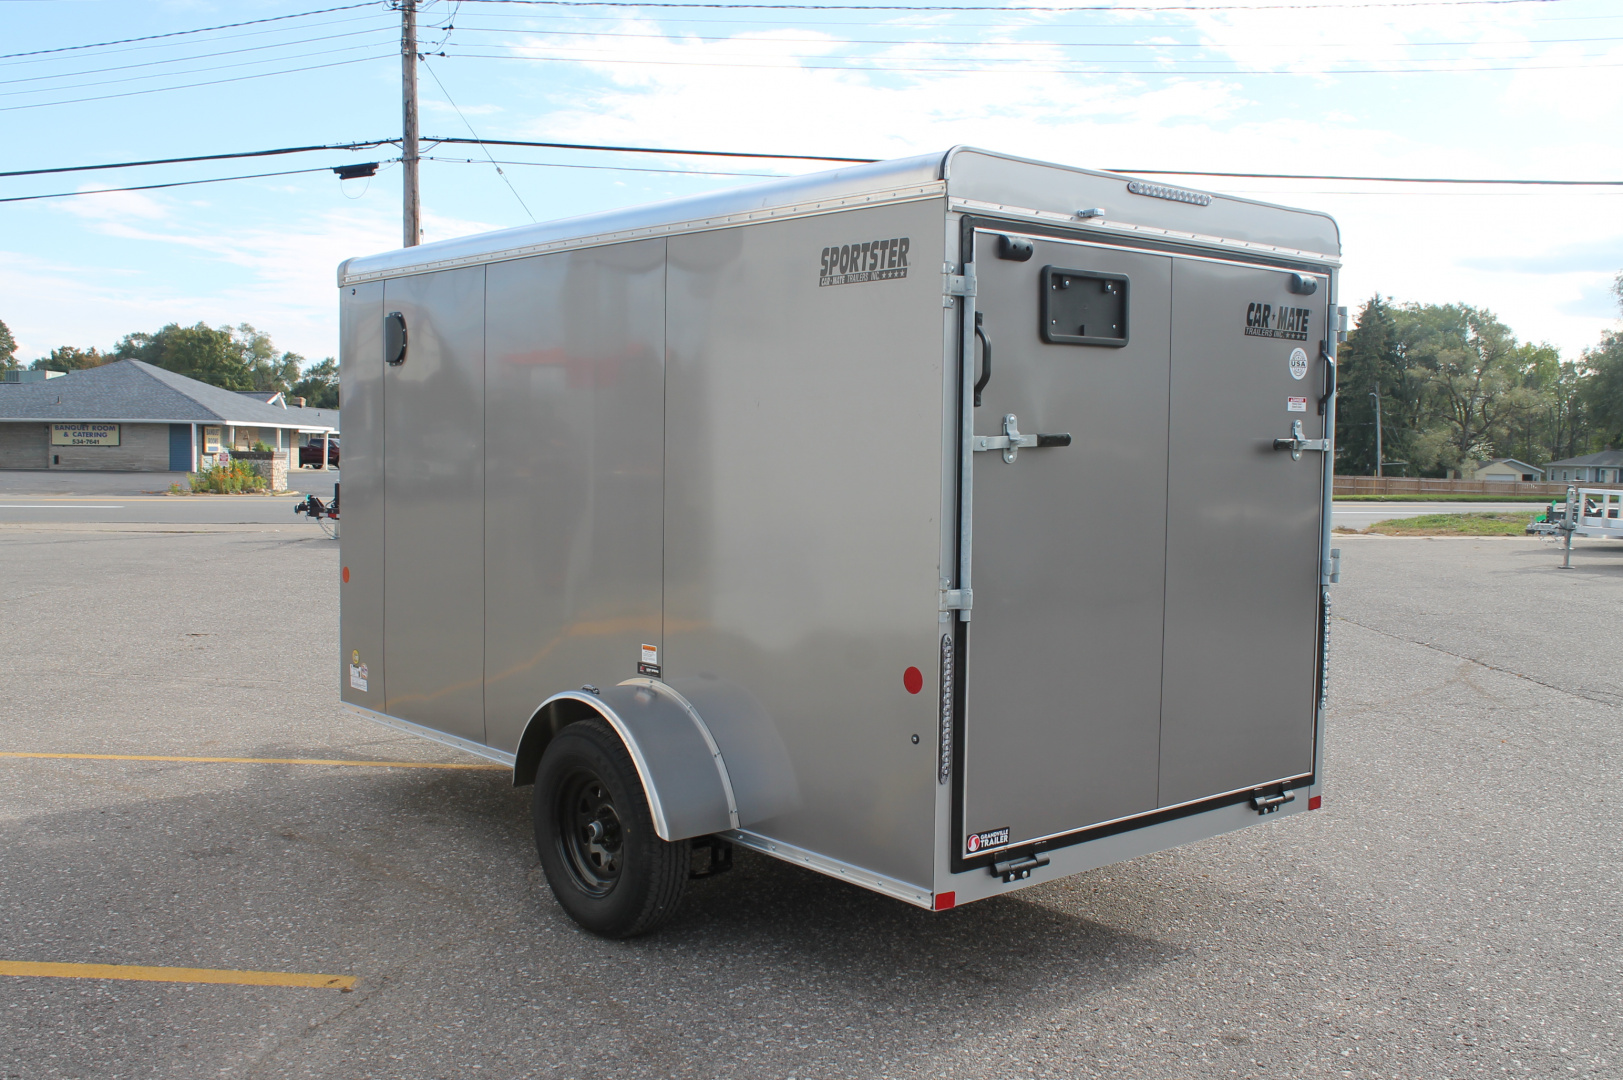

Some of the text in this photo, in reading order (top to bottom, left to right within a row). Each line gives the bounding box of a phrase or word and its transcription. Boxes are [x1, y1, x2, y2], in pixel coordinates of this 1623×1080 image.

[820, 237, 910, 276] SPORTSTER
[847, 272, 869, 283] TRAILERS
[1245, 327, 1273, 337] TRAILERS
[980, 829, 1009, 840] GRANDVILLE
[980, 835, 1009, 848] TRAILER
